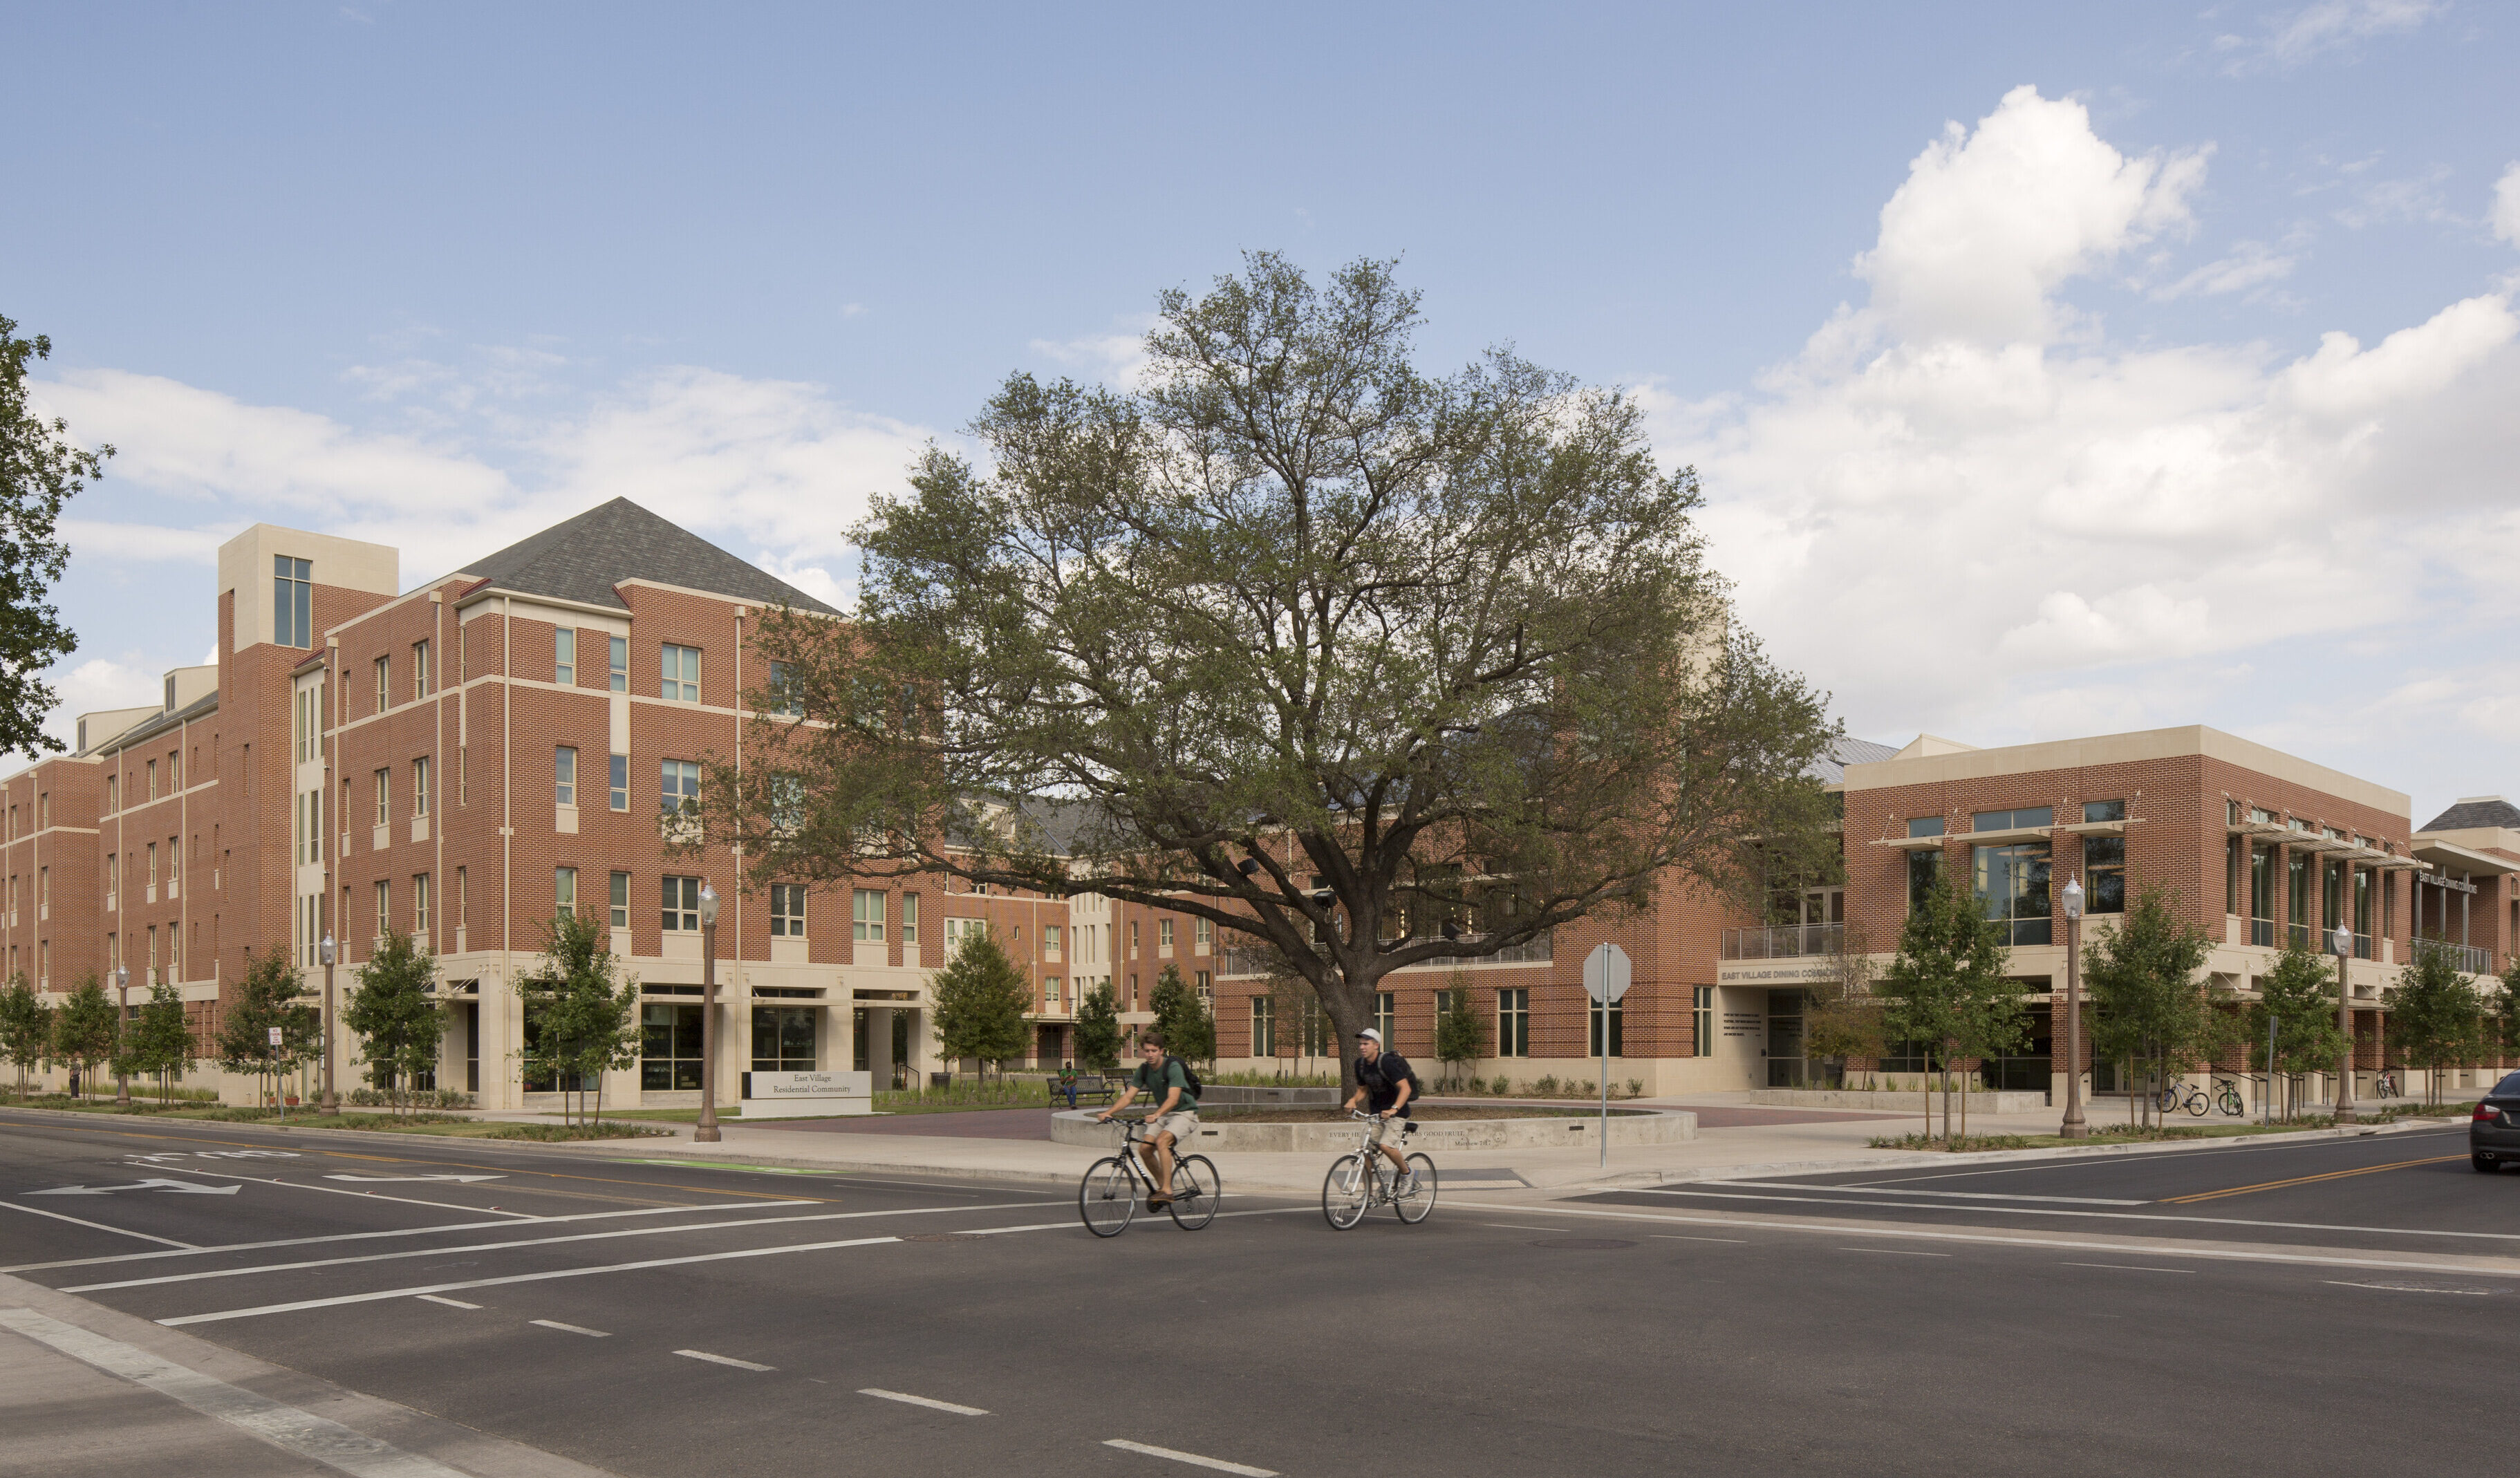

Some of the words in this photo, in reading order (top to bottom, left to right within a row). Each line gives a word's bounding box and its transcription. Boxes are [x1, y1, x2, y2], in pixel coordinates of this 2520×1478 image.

[2420, 872, 2429, 883] EAST
[2429, 874, 2445, 887] VILLAGE
[2445, 878, 2458, 890] DINING
[2458, 881, 2477, 894] COMMONS
[1742, 971, 1772, 979] VILLAGE
[1773, 970, 1800, 978] DINING
[809, 1074, 832, 1083] Village
[812, 1085, 851, 1094] Community
